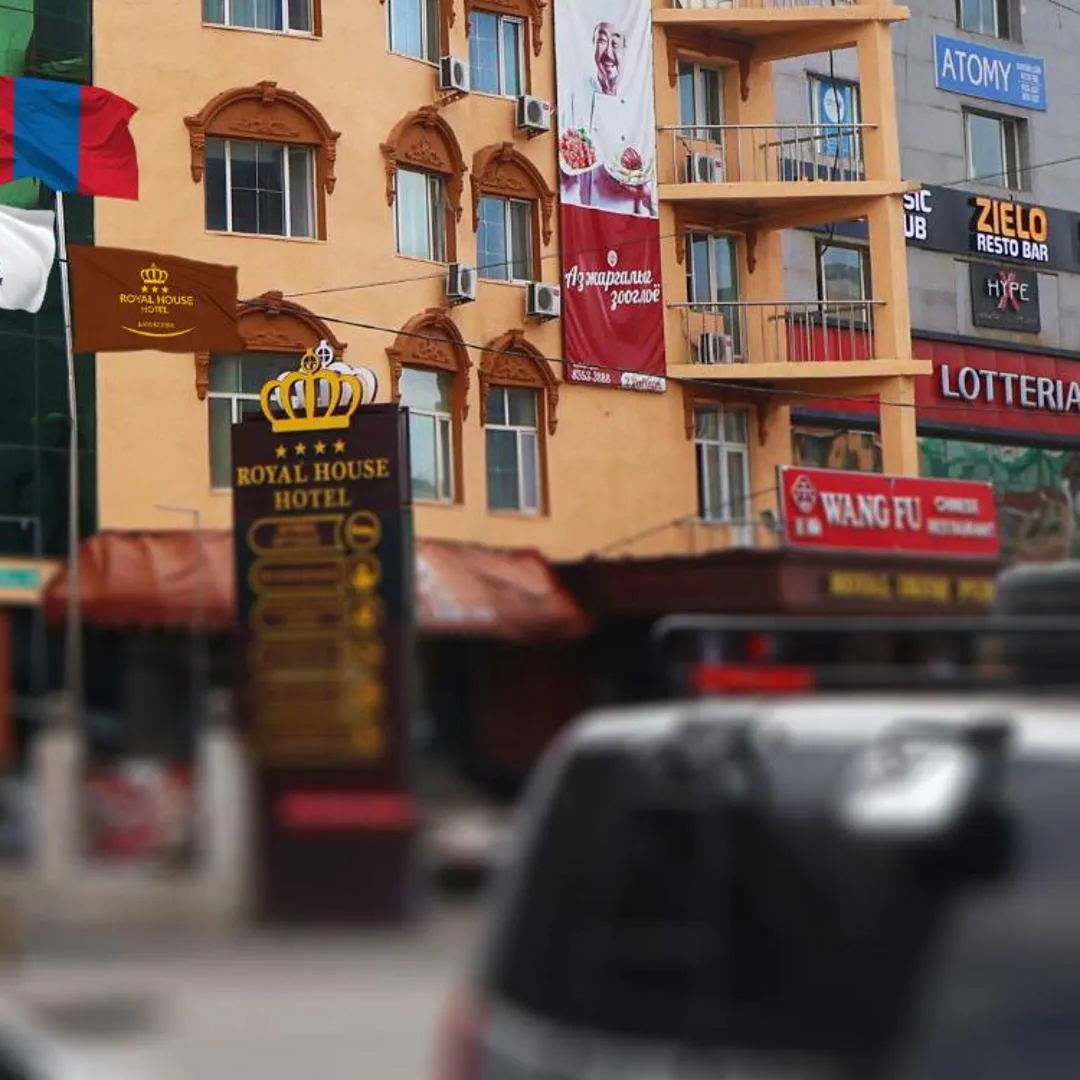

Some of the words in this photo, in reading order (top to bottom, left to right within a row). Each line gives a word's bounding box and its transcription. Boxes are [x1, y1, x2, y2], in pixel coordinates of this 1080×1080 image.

[942, 47, 1011, 92] ATOMY
[976, 197, 1048, 243] ZIELO
[977, 233, 1019, 257] RESTO
[1022, 241, 1049, 262] BAR
[120, 293, 155, 305] ROYAL
[157, 294, 194, 306] HOUSE
[987, 279, 1030, 301] HYPE
[141, 305, 169, 315] HOTEL
[941, 364, 1080, 412] LOTTERIA
[236, 463, 309, 486] ROYAL
[313, 458, 390, 482] HOUSE
[274, 487, 352, 511] HOTEL
[820, 491, 890, 528] WANG
[893, 495, 922, 530] FU
